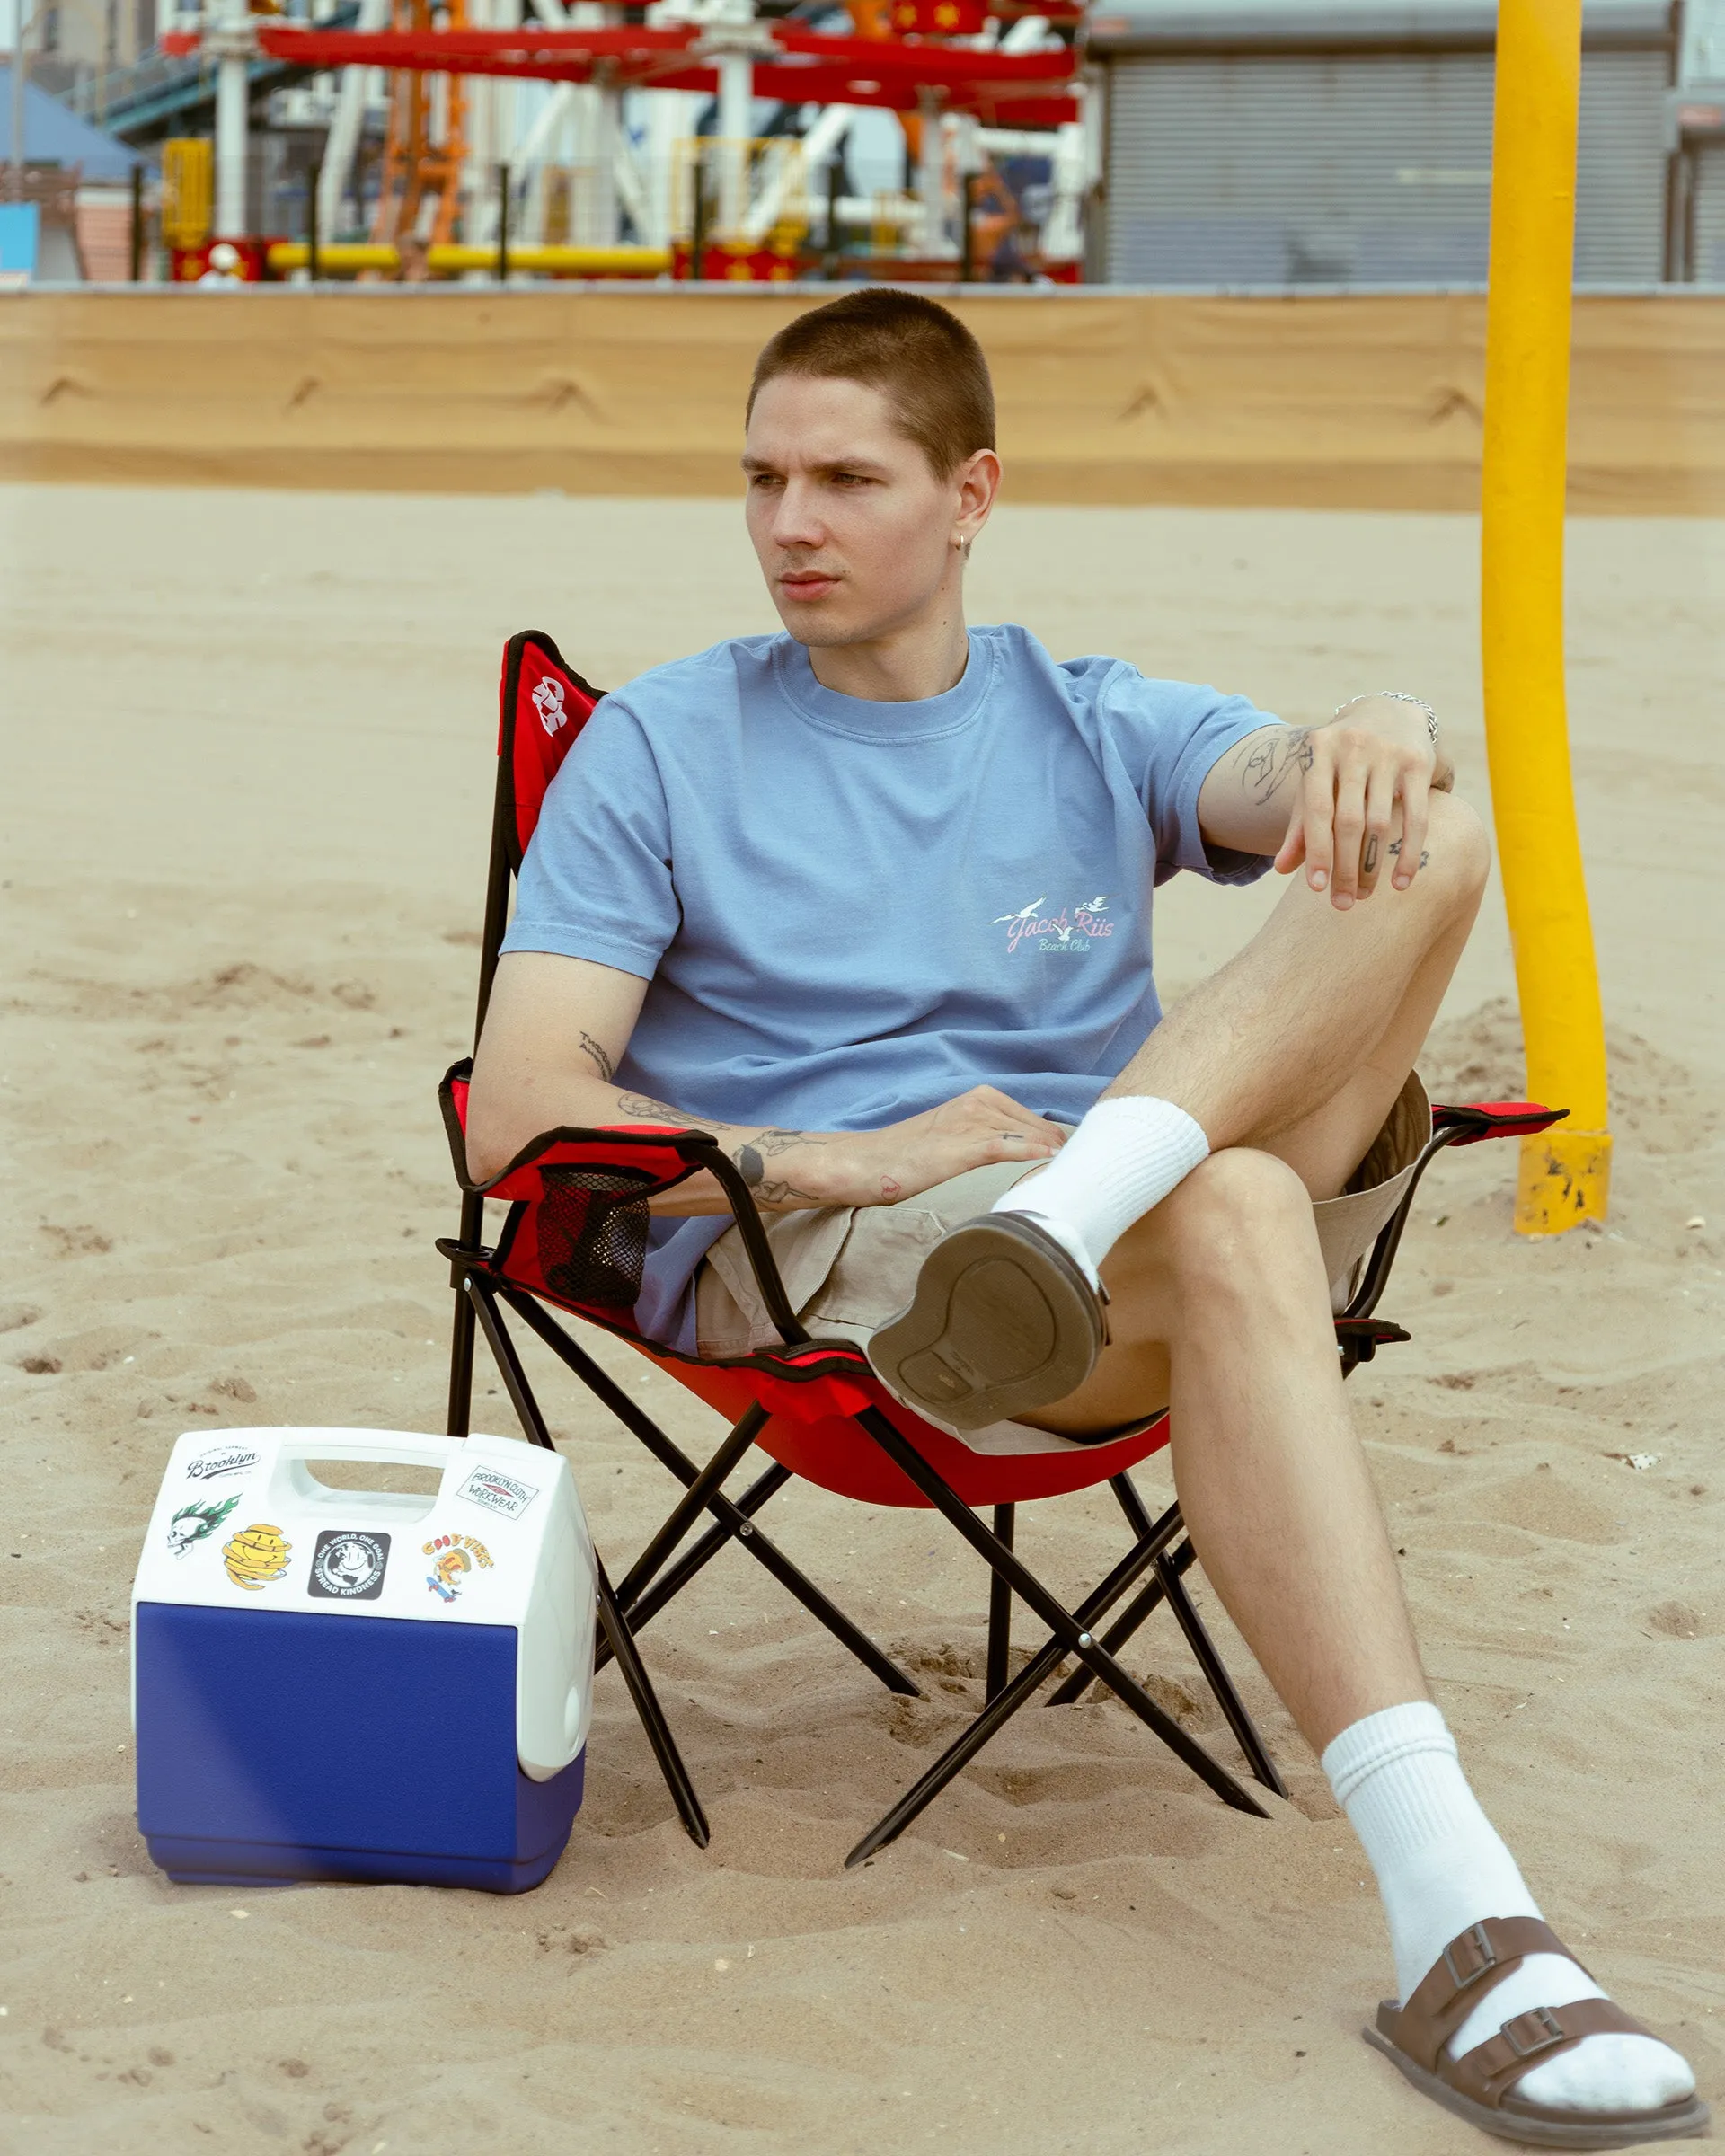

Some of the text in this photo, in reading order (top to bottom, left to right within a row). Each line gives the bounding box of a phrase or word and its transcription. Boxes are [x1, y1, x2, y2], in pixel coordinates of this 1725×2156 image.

[1075, 911, 1115, 937] Riis
[1039, 938, 1091, 952] Beach Club
[186, 1453, 256, 1479] Brooklyn
[468, 1484, 518, 1511] WORKWEAR
[471, 1472, 528, 1503] BROOKLYN CLOTH
[317, 1544, 330, 1559] ONE
[359, 1534, 375, 1545] ONE
[372, 1543, 385, 1561] GOAL
[314, 1568, 381, 1595] SPREAD KINDNESS
